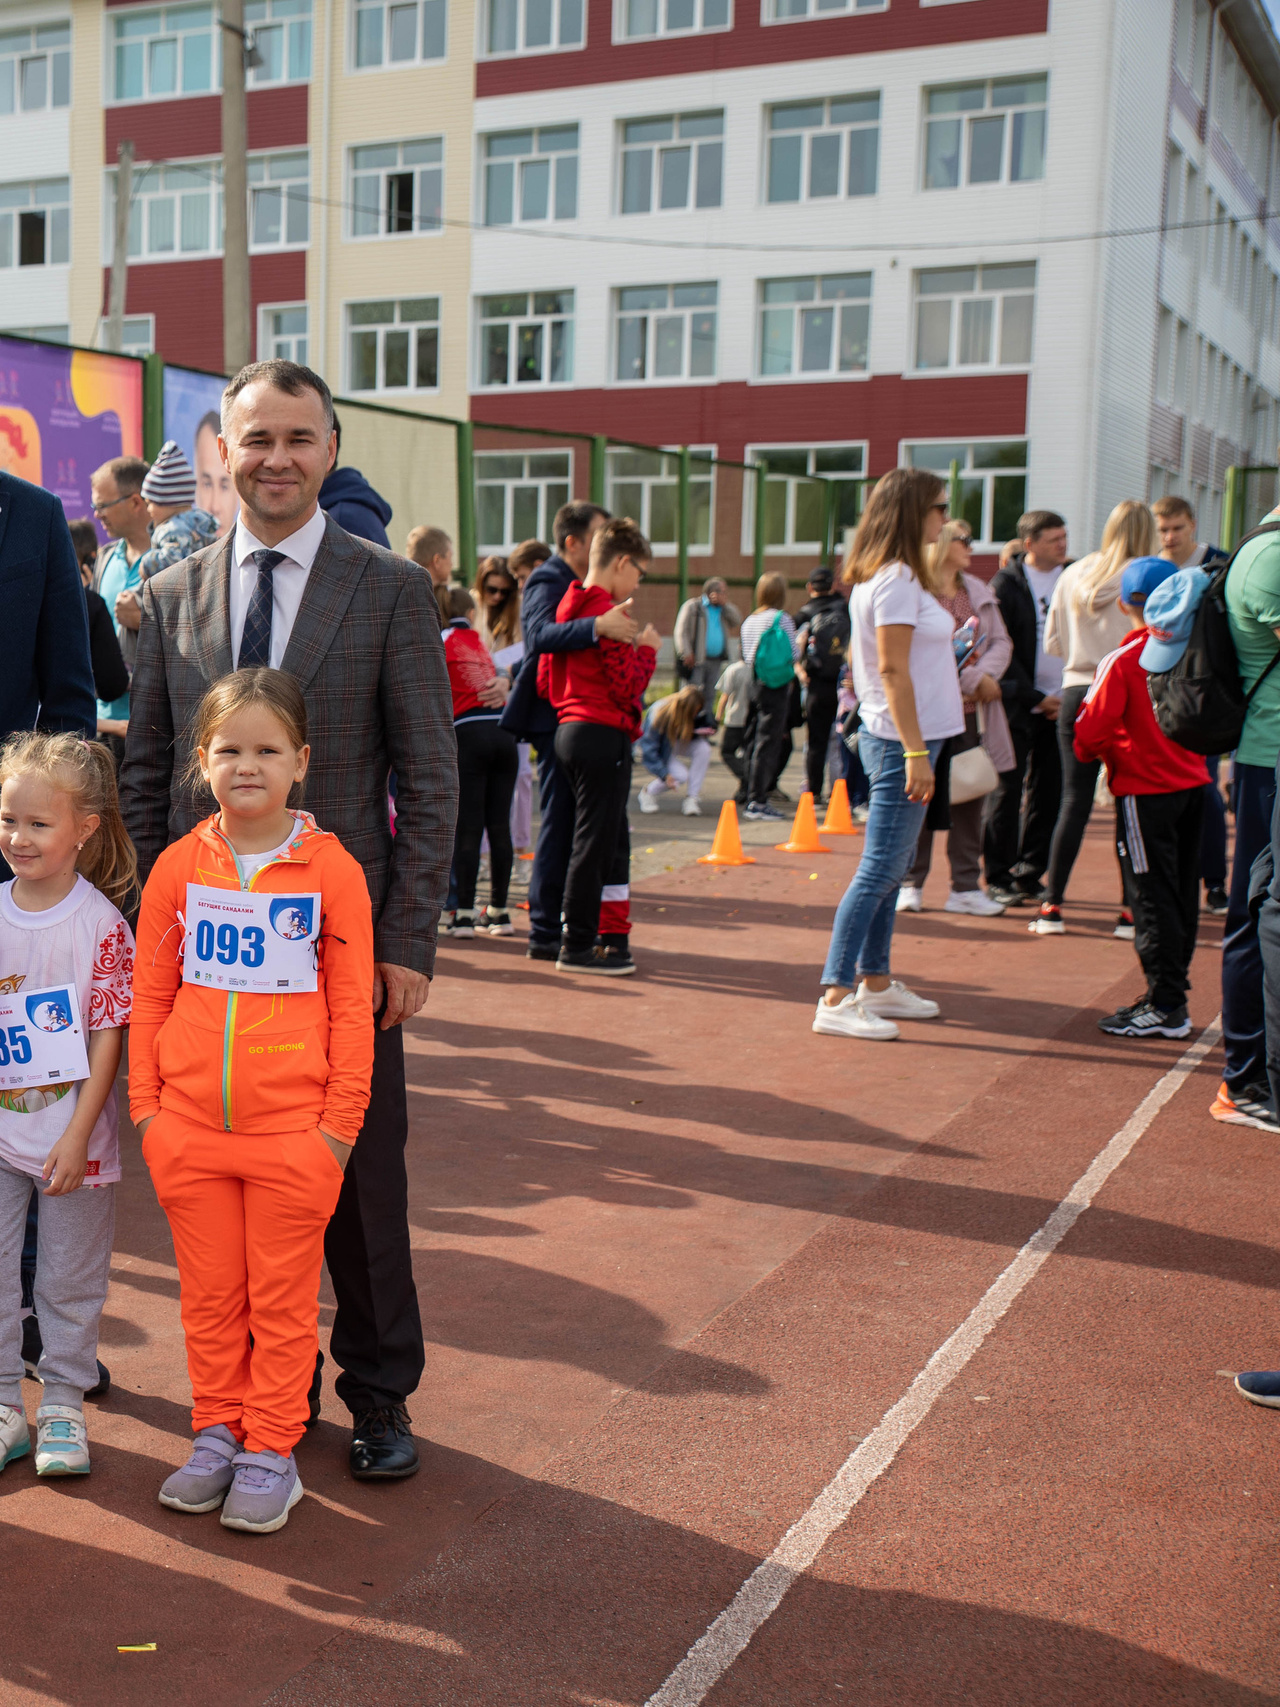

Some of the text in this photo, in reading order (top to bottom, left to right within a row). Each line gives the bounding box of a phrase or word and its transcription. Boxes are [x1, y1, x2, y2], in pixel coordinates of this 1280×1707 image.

[198, 901, 221, 910] БЕГУЩИЕ
[222, 905, 254, 914] САНДАЛИИ
[196, 919, 265, 968] 093
[248, 1042, 305, 1054] GO STRONG
